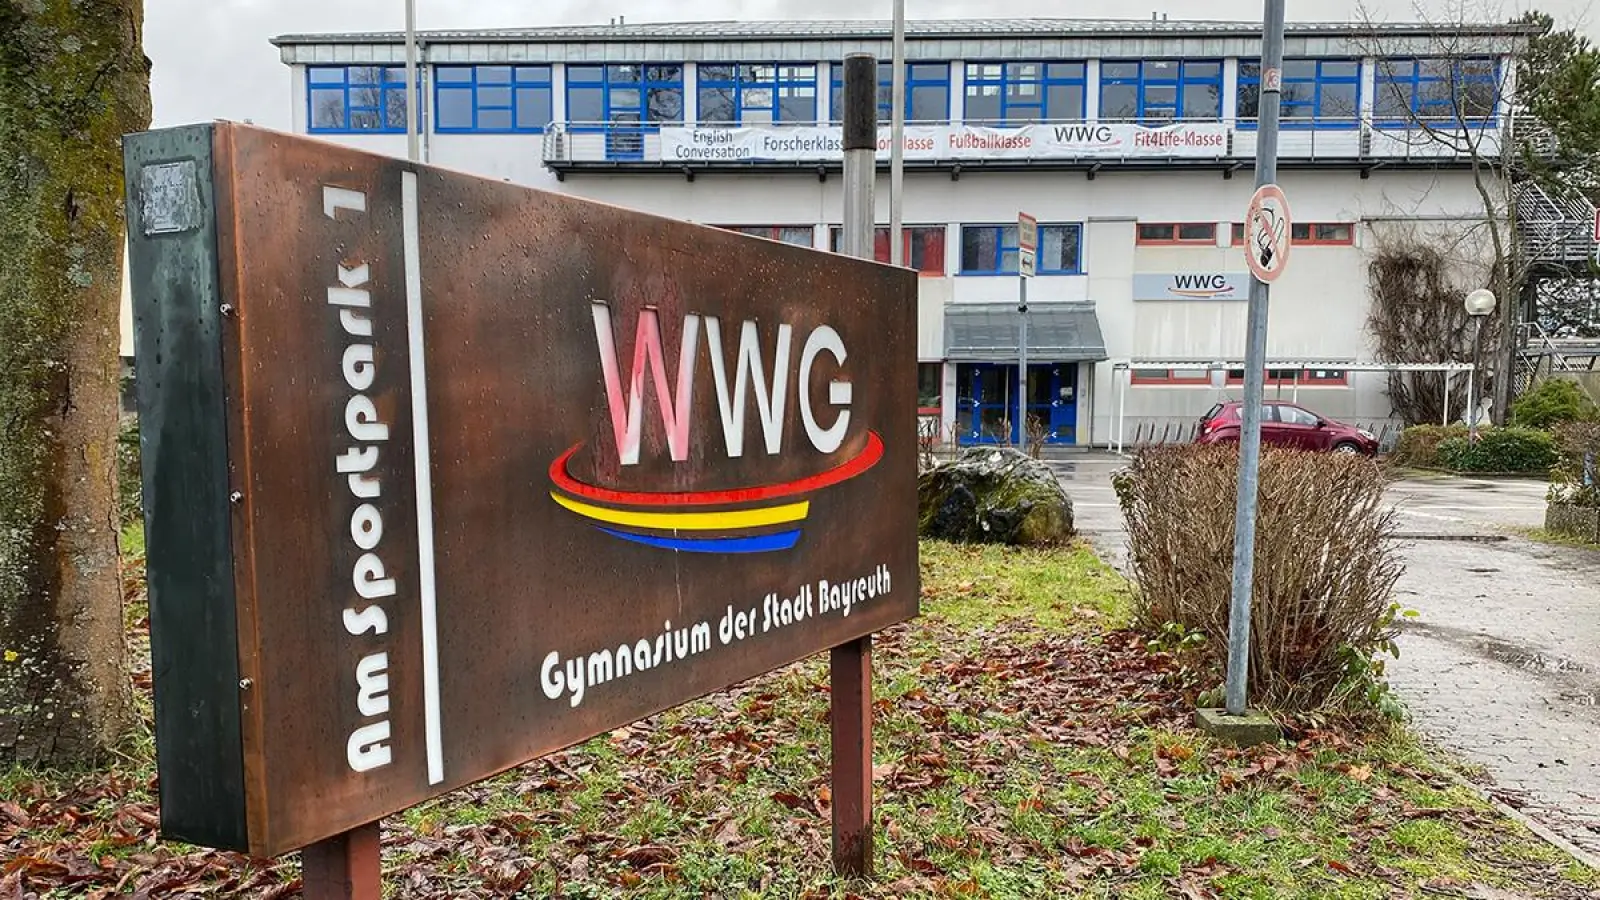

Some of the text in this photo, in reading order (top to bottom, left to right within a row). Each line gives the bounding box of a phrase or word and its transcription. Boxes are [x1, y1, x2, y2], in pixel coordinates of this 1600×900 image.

[693, 129, 733, 144] English
[949, 133, 1031, 149] Fußballklasse
[1054, 126, 1113, 143] WWG
[1134, 131, 1223, 147] Fit4Life-Klasse
[763, 135, 845, 151] Forscherklass
[675, 144, 750, 159] Conversation
[1174, 275, 1226, 289] WWG
[591, 299, 853, 466] WWG
[323, 186, 397, 774] Am Sportpark 1
[540, 563, 892, 707] Gymnasium der Stadt Bayreuth
